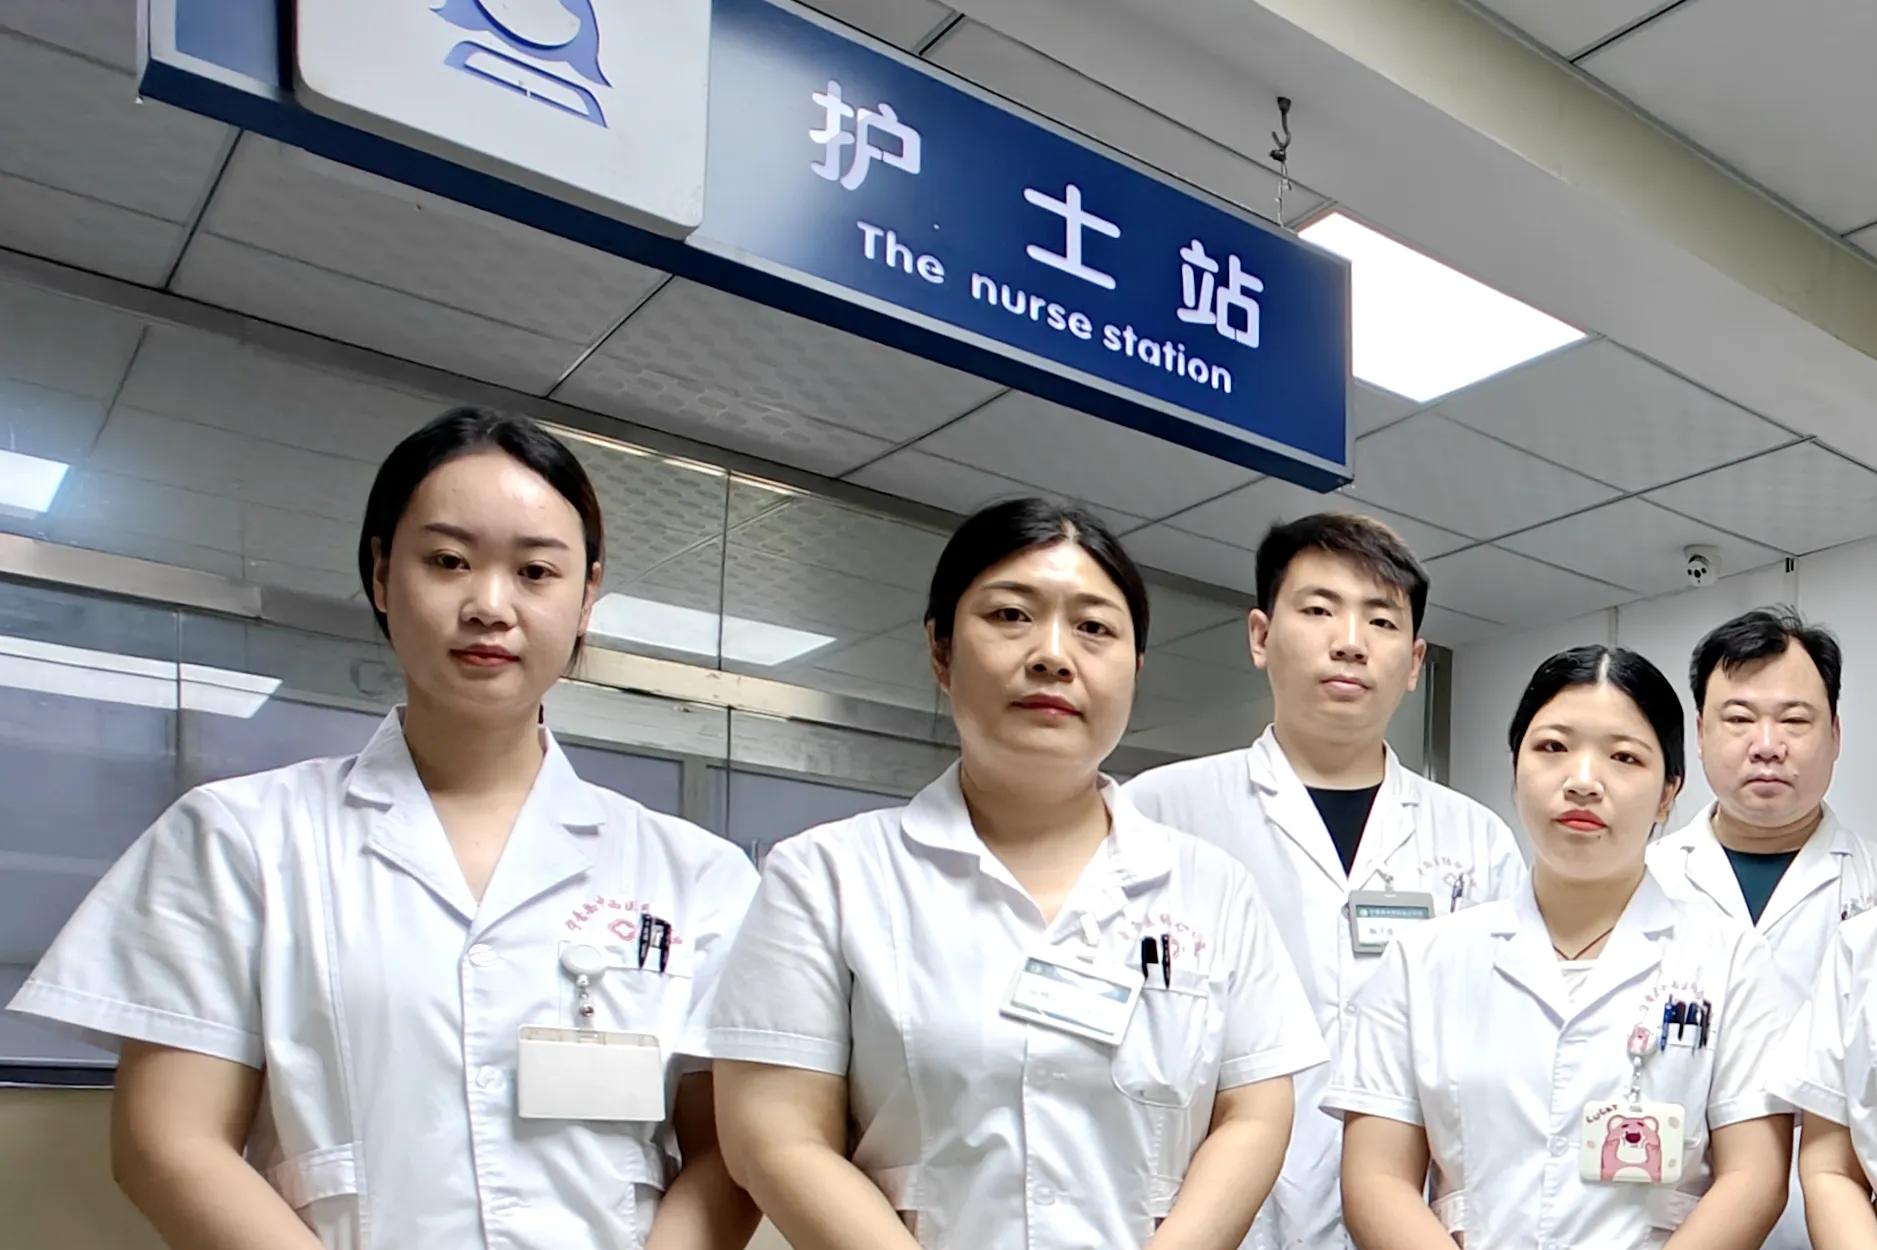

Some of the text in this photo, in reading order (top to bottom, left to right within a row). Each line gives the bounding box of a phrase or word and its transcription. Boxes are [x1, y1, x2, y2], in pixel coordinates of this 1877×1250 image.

[808, 79, 1264, 349] 护士站
[858, 221, 1233, 394] The nurse station
